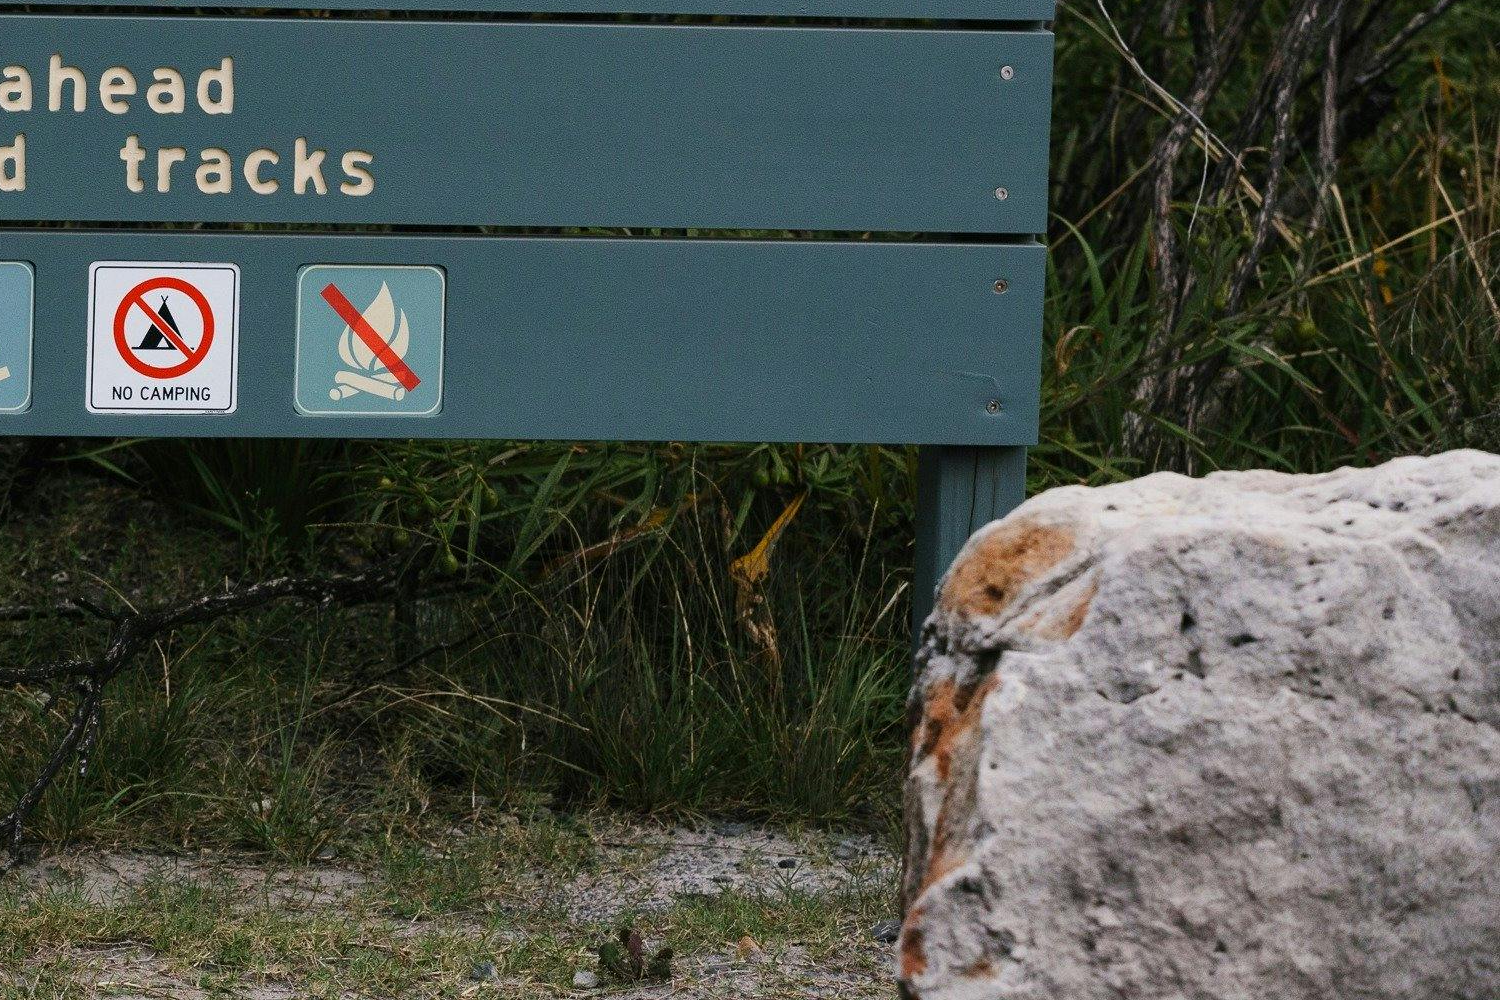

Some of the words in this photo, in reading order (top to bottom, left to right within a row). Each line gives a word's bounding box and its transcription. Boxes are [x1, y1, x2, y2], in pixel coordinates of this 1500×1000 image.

[119, 135, 376, 198] tracks
[112, 387, 133, 400] NO
[140, 387, 211, 402] CAMPING
